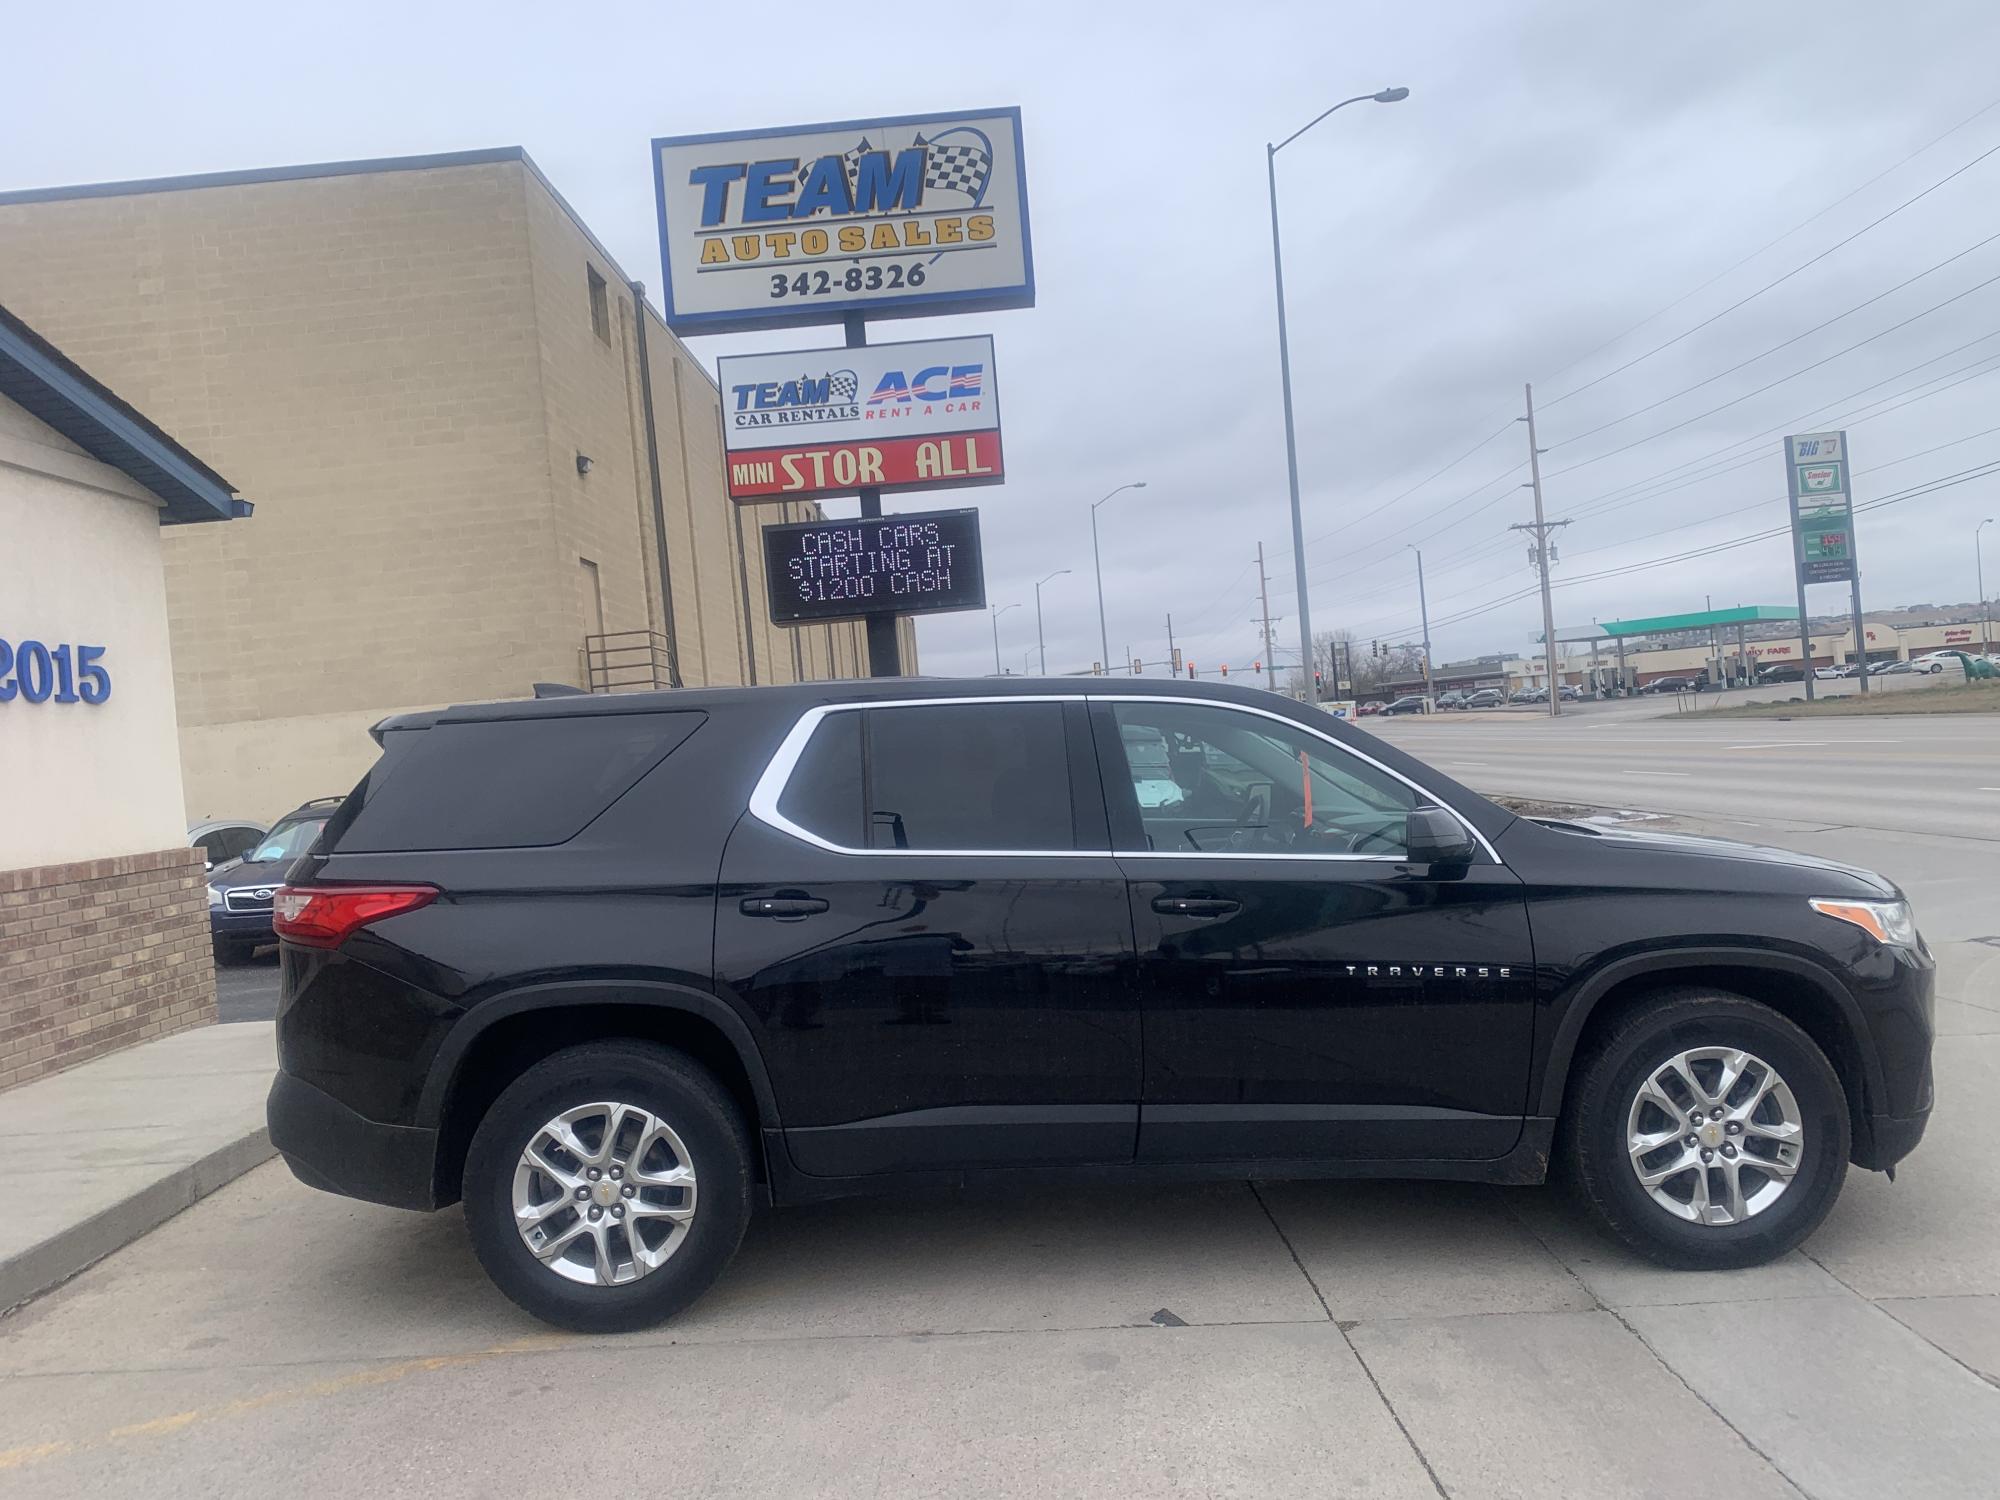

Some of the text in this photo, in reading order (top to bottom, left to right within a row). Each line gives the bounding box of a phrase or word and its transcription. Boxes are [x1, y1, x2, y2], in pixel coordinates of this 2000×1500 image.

[688, 147, 928, 228] TEAM
[700, 215, 996, 264] AUTO SALES
[770, 262, 926, 298] 342-8326
[732, 377, 832, 410] TEAM
[866, 364, 984, 405] ACE
[735, 405, 860, 426] CAR RENTALS
[866, 401, 982, 420] RENT A CAR
[733, 438, 993, 490] MINI STOR ALL
[801, 522, 941, 556] CASH CARS
[788, 544, 956, 580] STARTING AT
[799, 568, 952, 602] $1200 CASH
[0, 637, 112, 705] 2015
[1345, 965, 1511, 978] TRAVERSE
